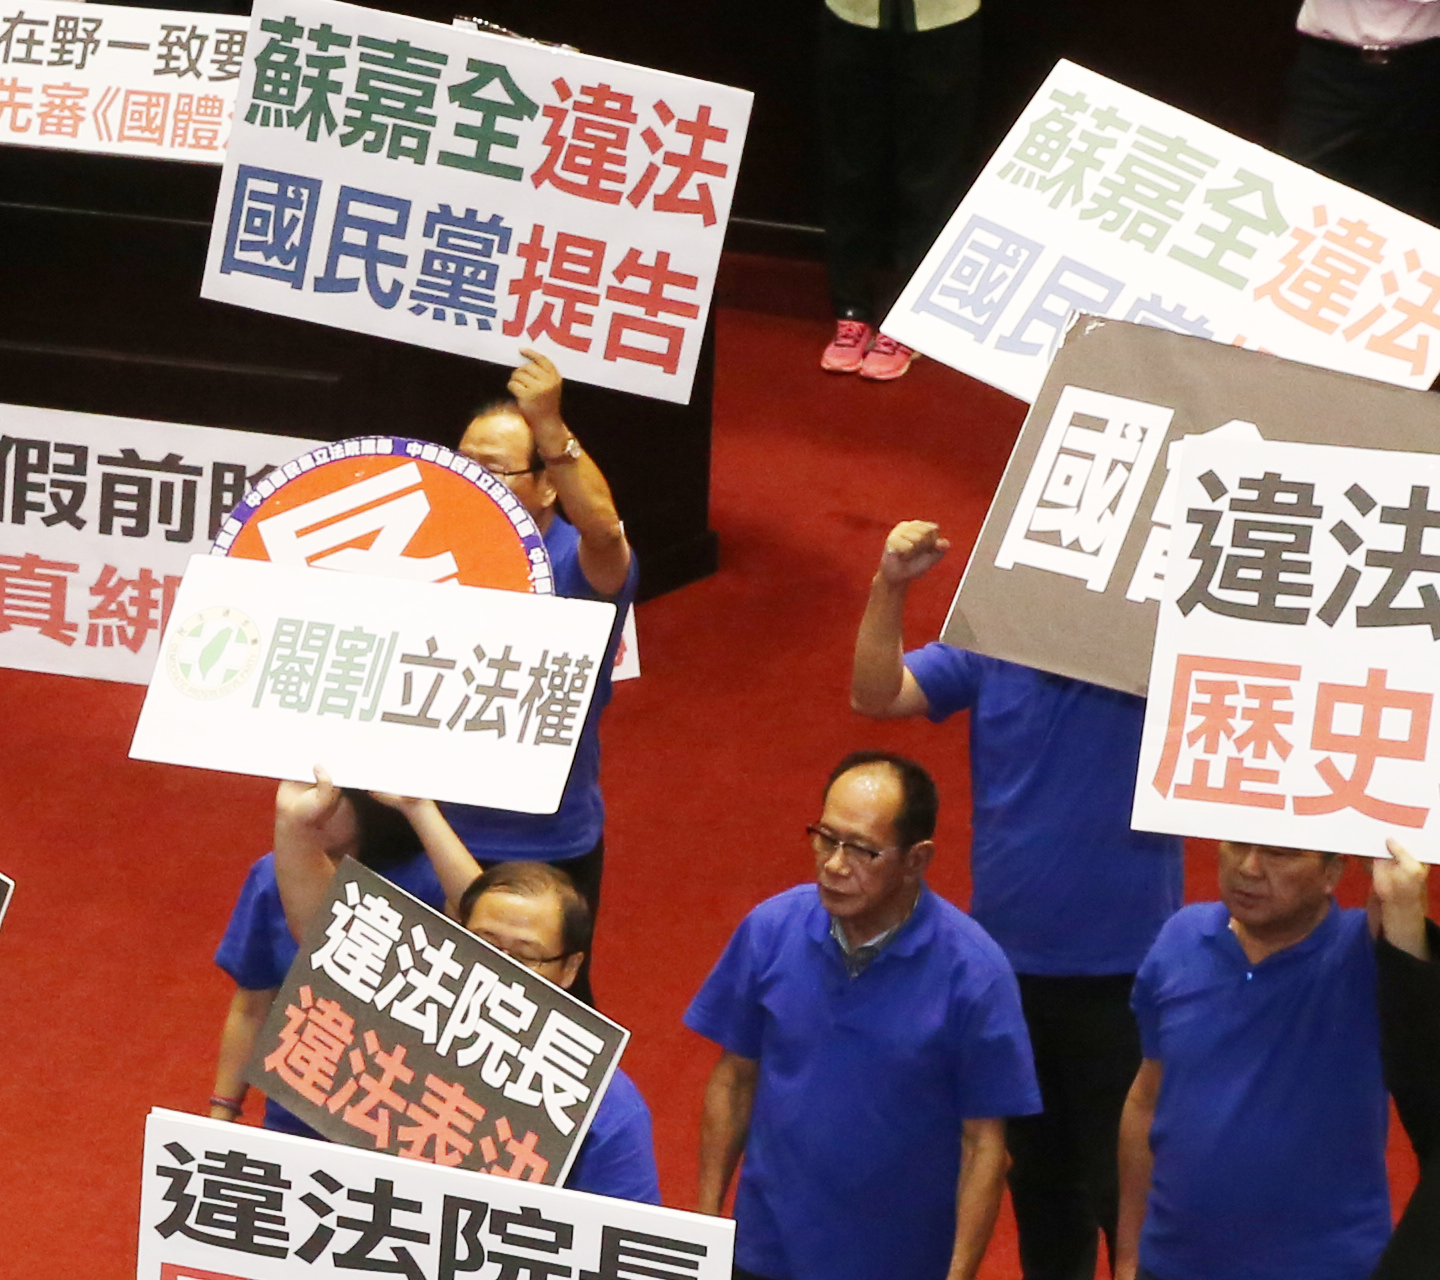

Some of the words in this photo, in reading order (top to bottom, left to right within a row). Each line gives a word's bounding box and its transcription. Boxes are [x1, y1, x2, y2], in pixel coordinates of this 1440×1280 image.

[243, 15, 729, 228] 蘇嘉全違法
[220, 165, 702, 374] 國民黨提告
[254, 617, 595, 747] 閹割立法權
[310, 881, 605, 1138] 違法院長
